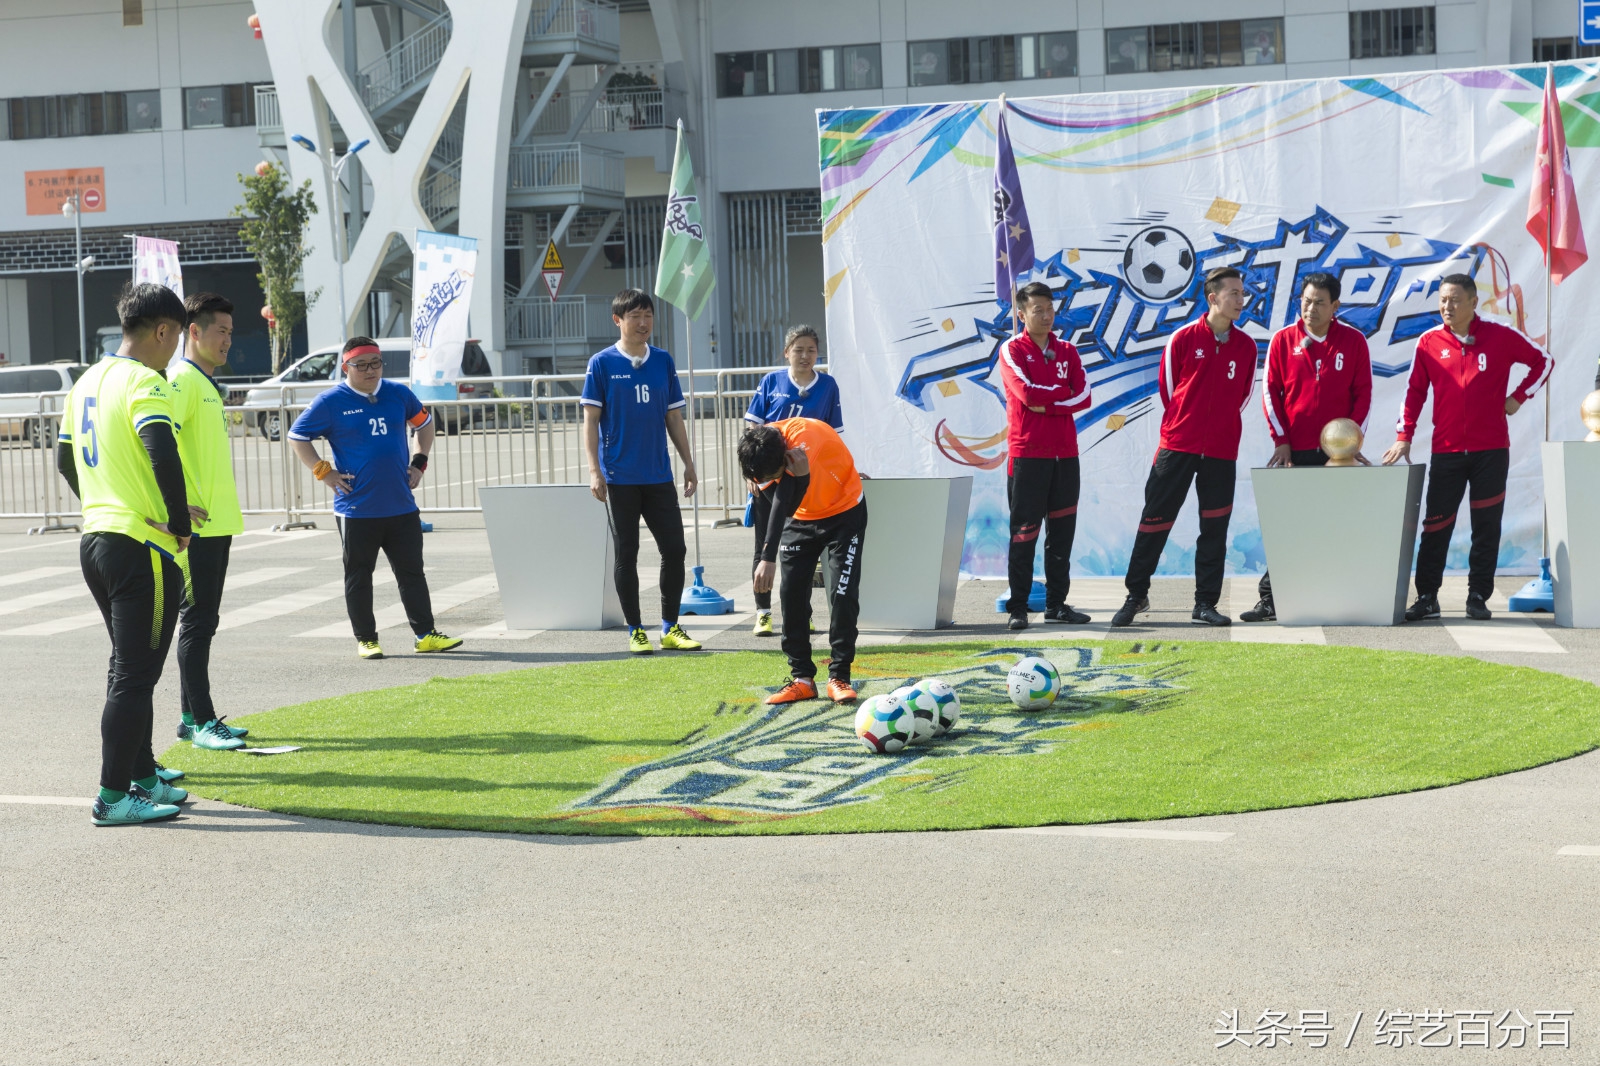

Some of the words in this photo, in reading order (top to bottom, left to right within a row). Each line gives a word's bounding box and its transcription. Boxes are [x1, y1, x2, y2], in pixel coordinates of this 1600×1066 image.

[1056, 361, 1069, 379] 32
[1227, 360, 1237, 380] 3
[1335, 352, 1344, 371] 6
[1478, 353, 1487, 371] 9
[634, 384, 650, 404] 16
[342, 408, 364, 416] KELME
[81, 396, 99, 469] 5
[368, 417, 388, 436] 25
[836, 544, 857, 595] KELME
[1015, 684, 1021, 694] 5
